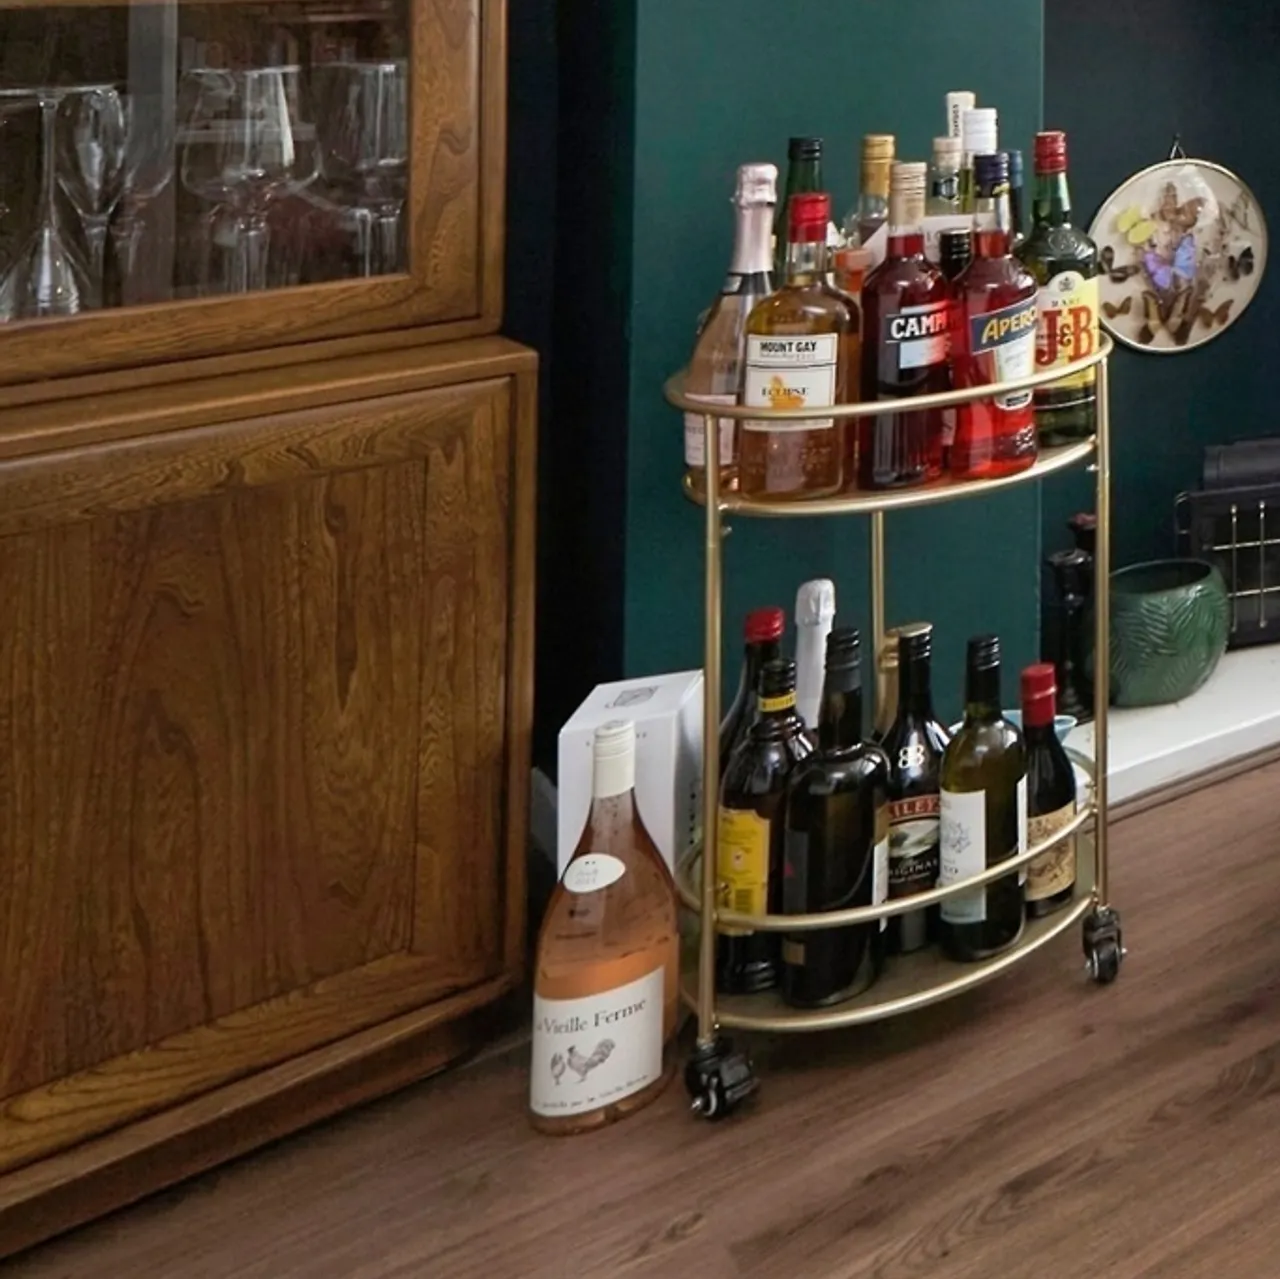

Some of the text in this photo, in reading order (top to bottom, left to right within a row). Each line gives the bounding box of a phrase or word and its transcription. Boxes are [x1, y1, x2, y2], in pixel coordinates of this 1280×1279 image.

[760, 340, 817, 353] MOUNT GAY
[1035, 305, 1094, 367] J&B
[594, 999, 646, 1028] Ferme
